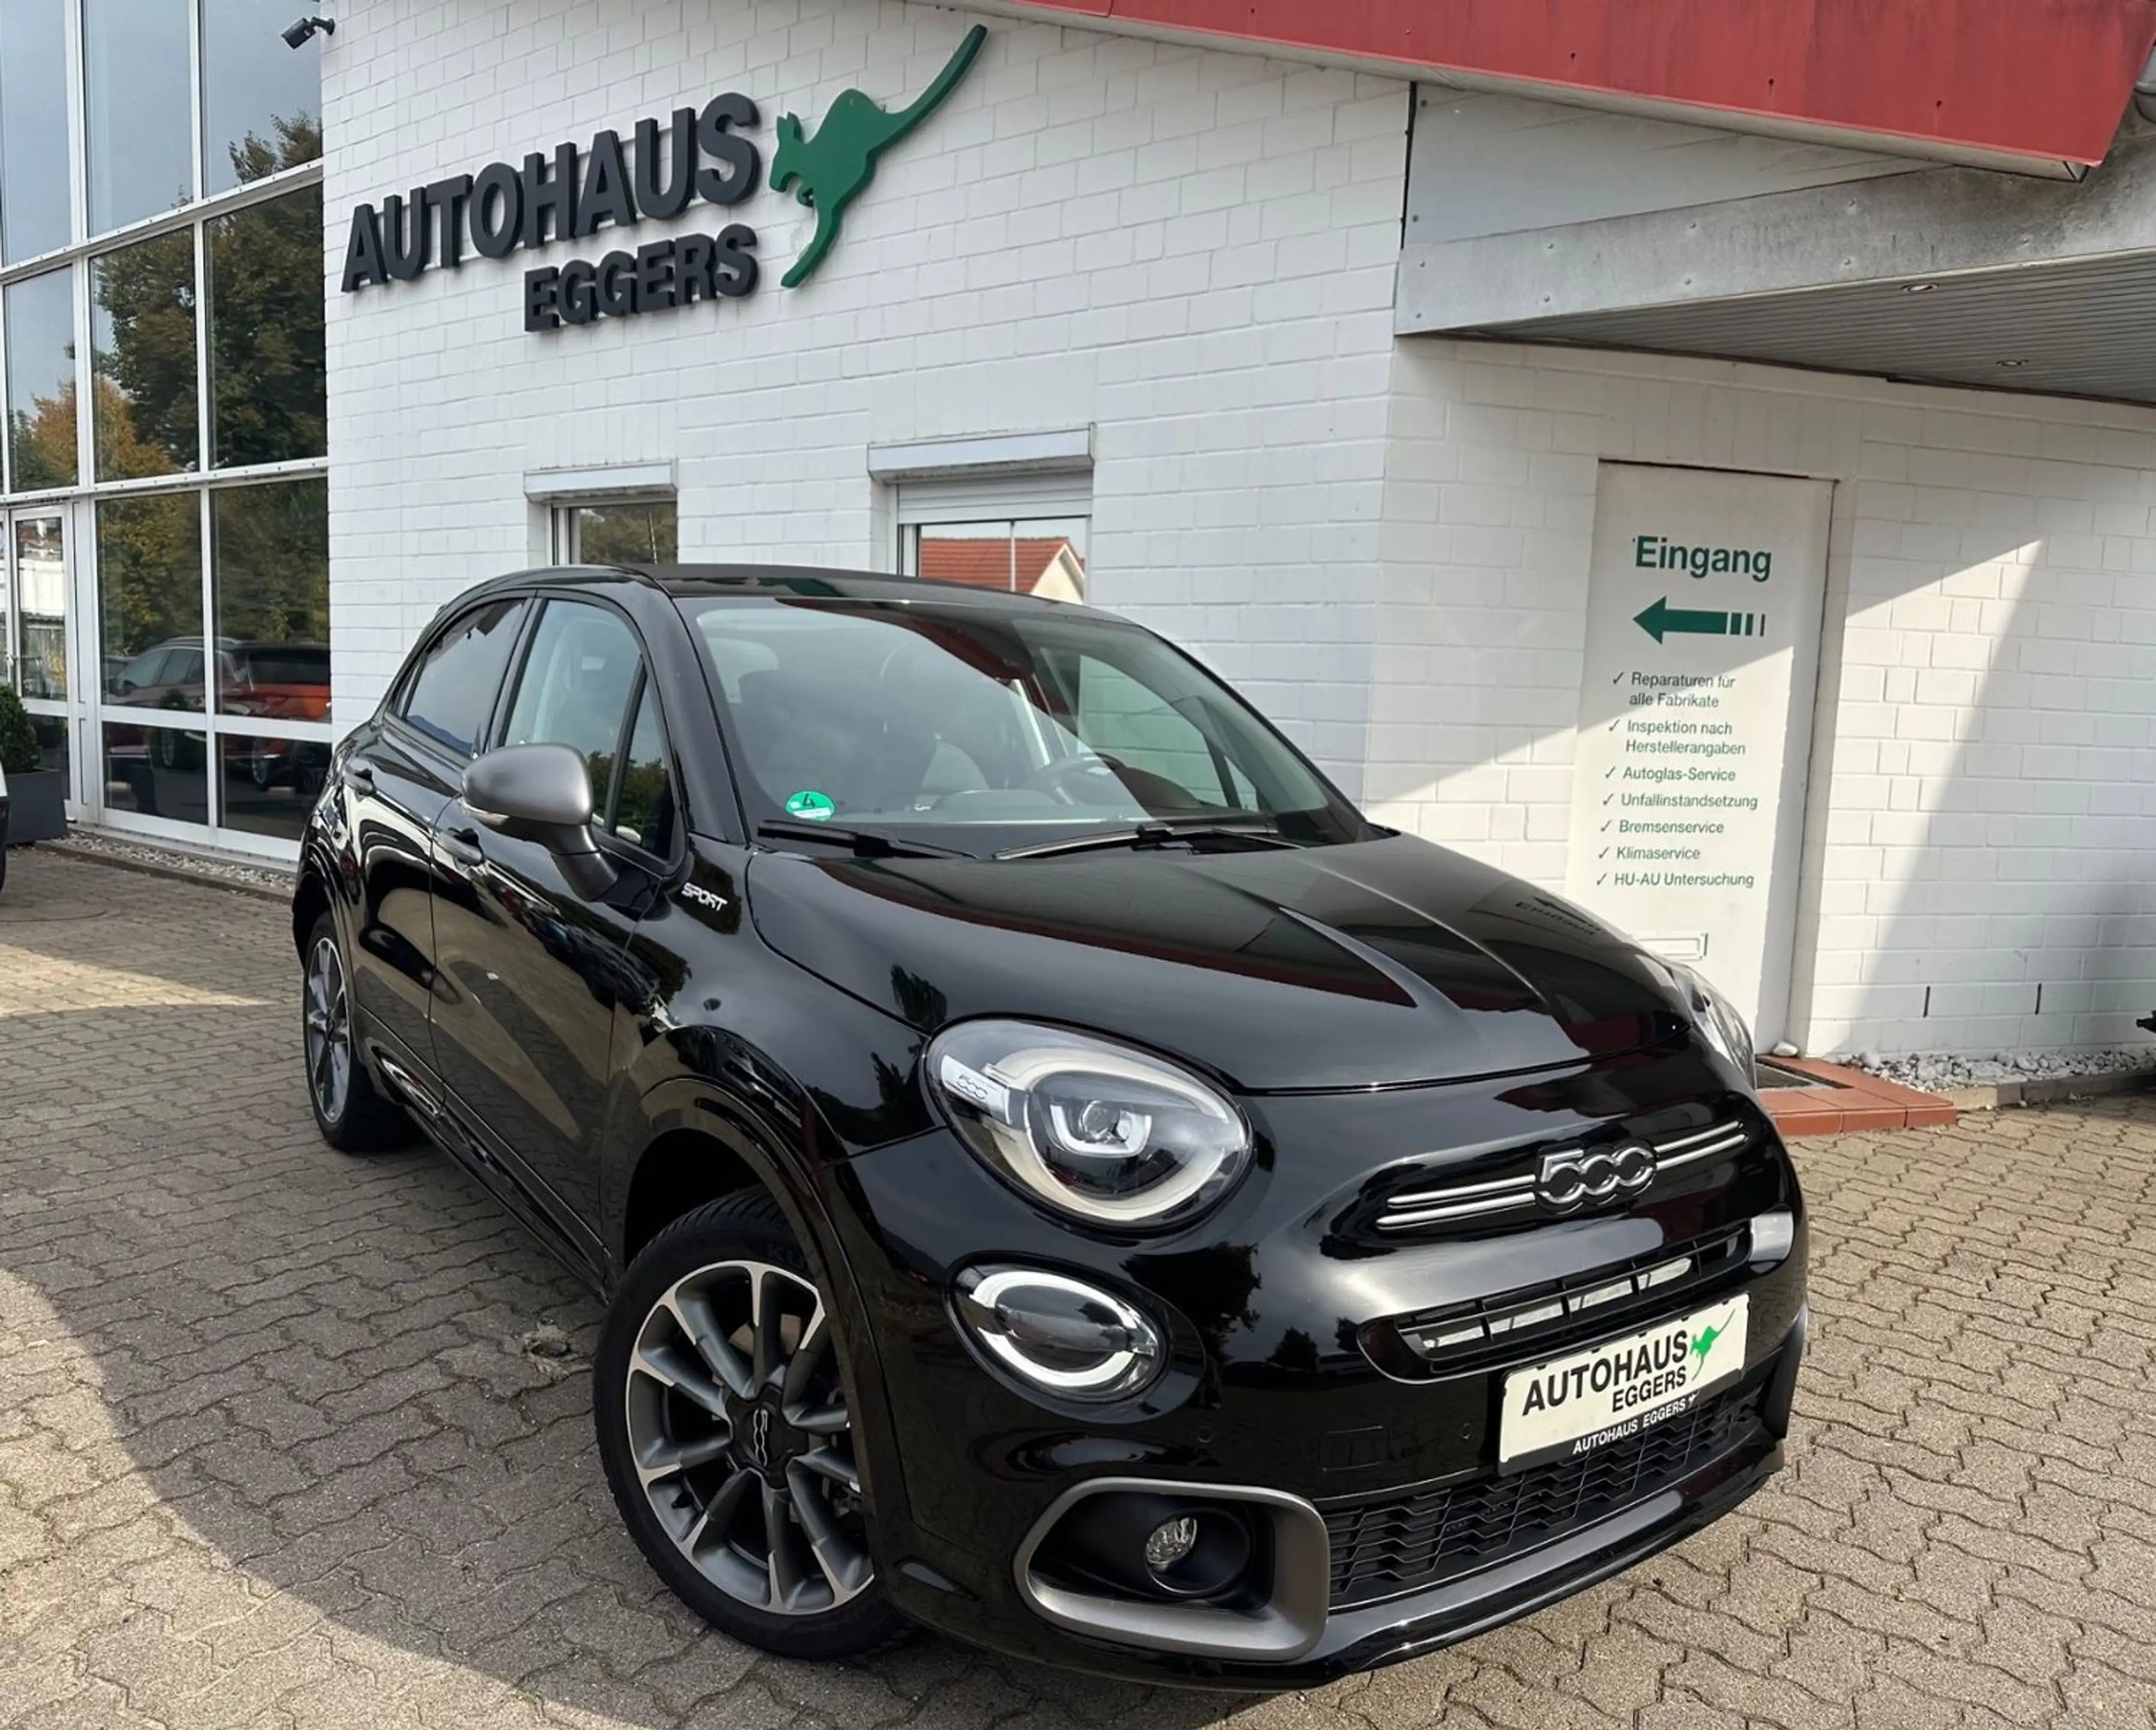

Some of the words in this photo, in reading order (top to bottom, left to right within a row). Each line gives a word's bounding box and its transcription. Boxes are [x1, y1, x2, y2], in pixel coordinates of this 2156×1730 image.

[341, 91, 762, 292] AUTOHAUS
[524, 223, 759, 333] EGGERS
[1635, 535, 1772, 582] Eingang
[1631, 672, 1713, 688] Reparaturen
[1629, 693, 1653, 706] alle
[1657, 693, 1719, 708] Fabrikate
[1627, 720, 1697, 735] Inspektion
[1700, 722, 1733, 735] nach
[1625, 739, 1746, 757] Herstellerangaben
[1622, 766, 1736, 783] Autoglas-Service
[802, 792, 816, 808] 4
[1621, 792, 1758, 811] Unfallinstandsetzung
[1619, 819, 1725, 834] Bremsenservice
[1616, 846, 1701, 860] Klimaservice
[1614, 872, 1661, 886] HU-AU
[1664, 872, 1755, 889] Untersuchung
[681, 882, 728, 912] SPORT
[957, 1073, 989, 1100] 500
[1536, 1144, 1657, 1206] 500
[1521, 1329, 1688, 1416] AUTOHAUS
[1612, 1365, 1686, 1413] EGGERS
[1572, 1419, 1639, 1455] AUTOHAUS
[1642, 1400, 1686, 1428] EGGERS
